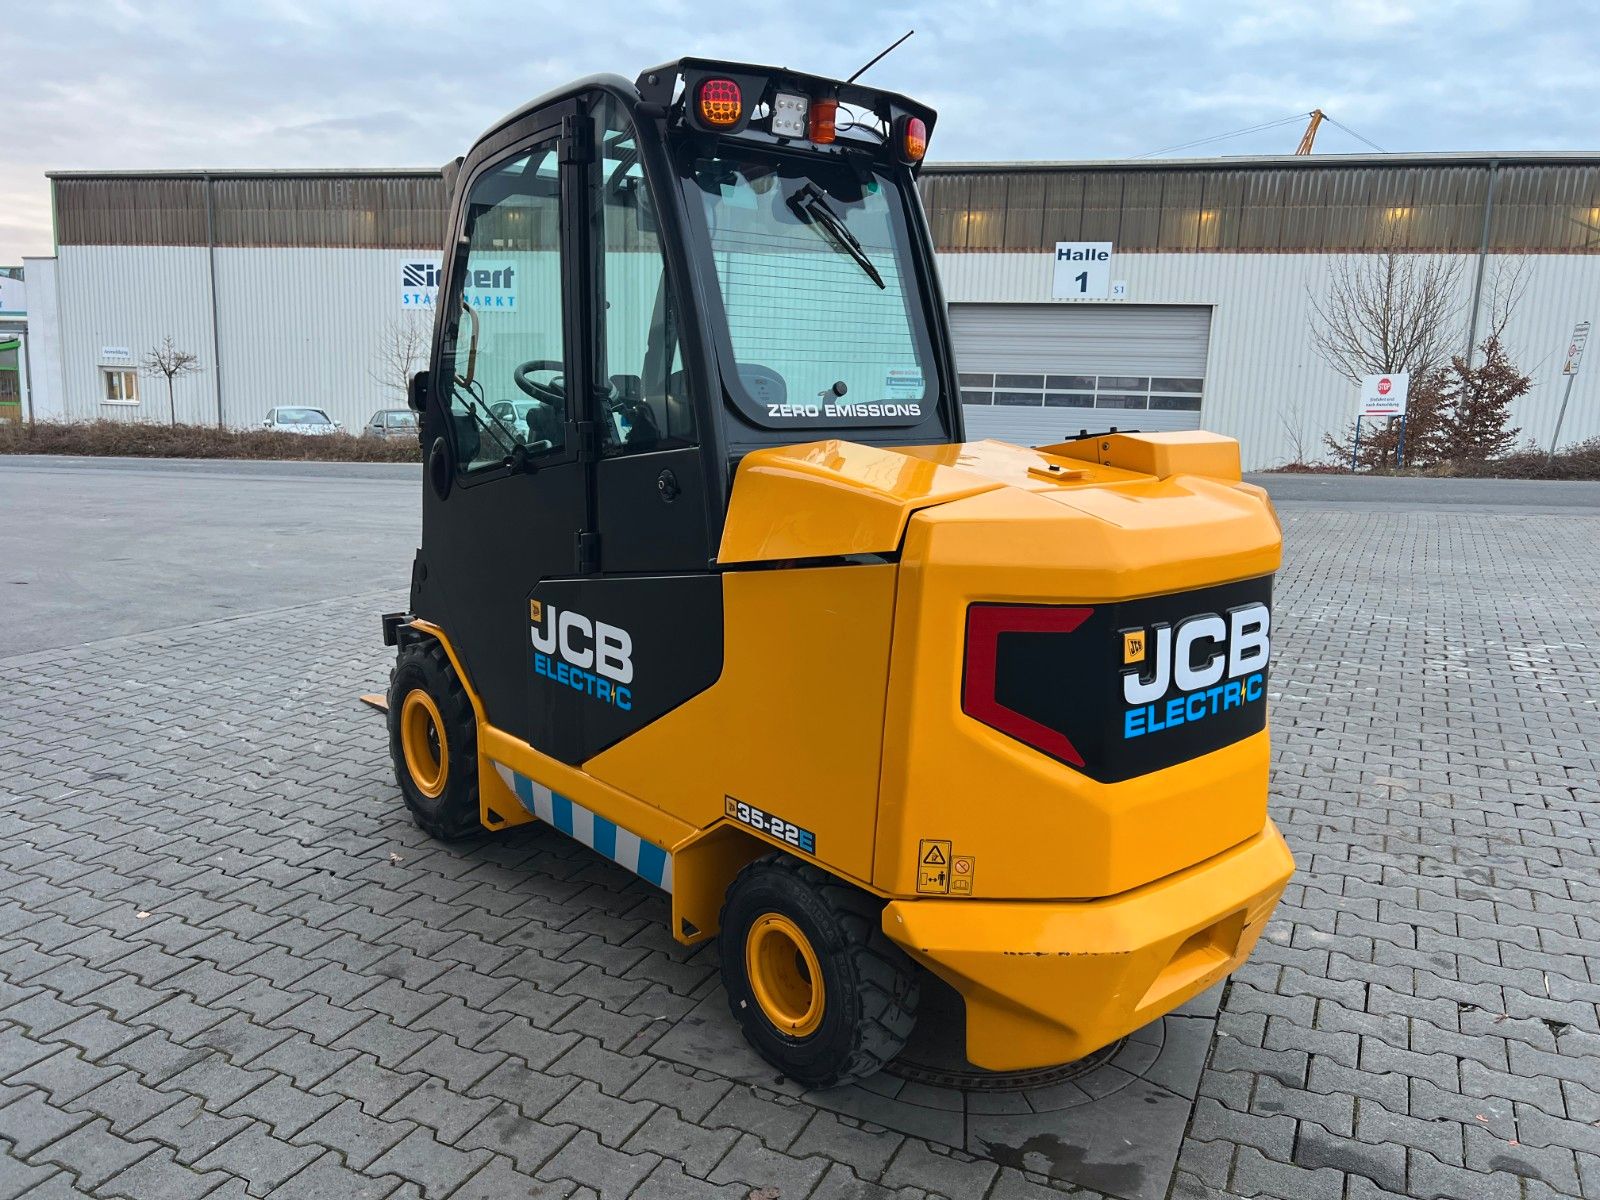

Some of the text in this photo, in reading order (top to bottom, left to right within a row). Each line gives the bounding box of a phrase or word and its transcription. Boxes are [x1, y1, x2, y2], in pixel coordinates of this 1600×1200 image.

[1057, 248, 1109, 261] Halle
[403, 264, 515, 288] Siert
[1075, 271, 1088, 293] 1
[767, 404, 921, 417] ZERO EMISSIONS
[530, 604, 634, 684] JCB
[1123, 605, 1270, 705] JCB
